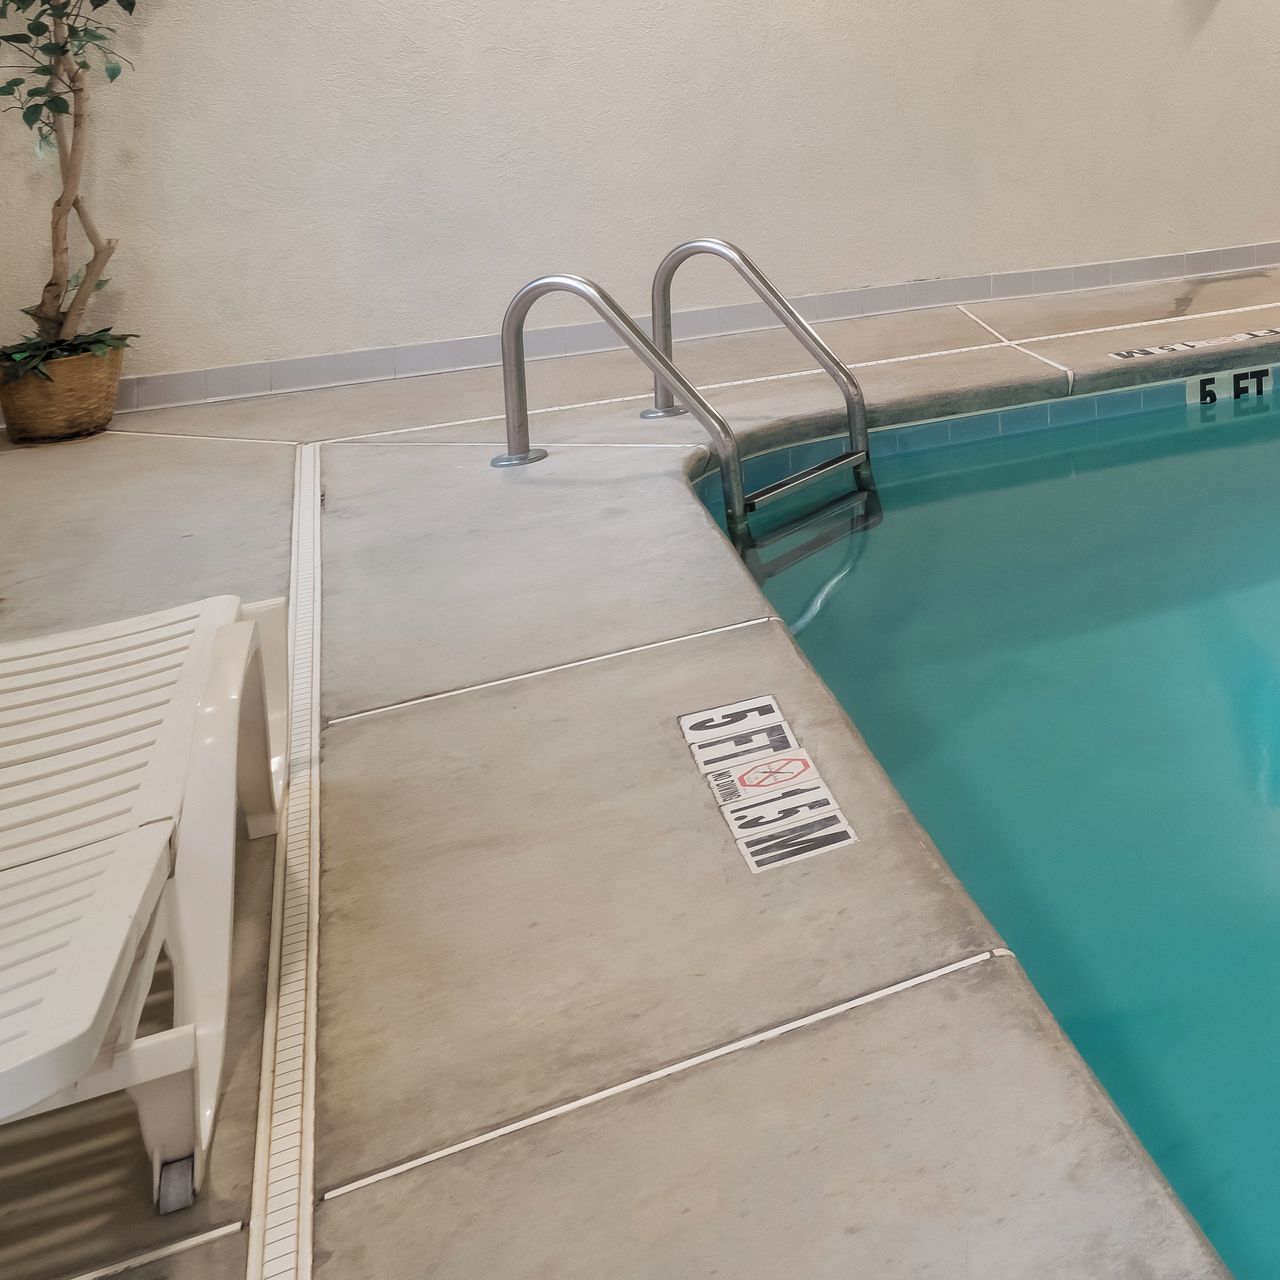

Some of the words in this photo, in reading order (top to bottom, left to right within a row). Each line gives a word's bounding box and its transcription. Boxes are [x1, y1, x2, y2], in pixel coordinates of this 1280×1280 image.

[1200, 377, 1217, 405] 5
[1233, 368, 1270, 400] FT
[688, 703, 775, 732] 5
[697, 723, 791, 767] FT
[711, 770, 725, 782] NO
[715, 778, 743, 803] DIVING
[730, 786, 831, 830] 1.5
[744, 814, 852, 868] M
